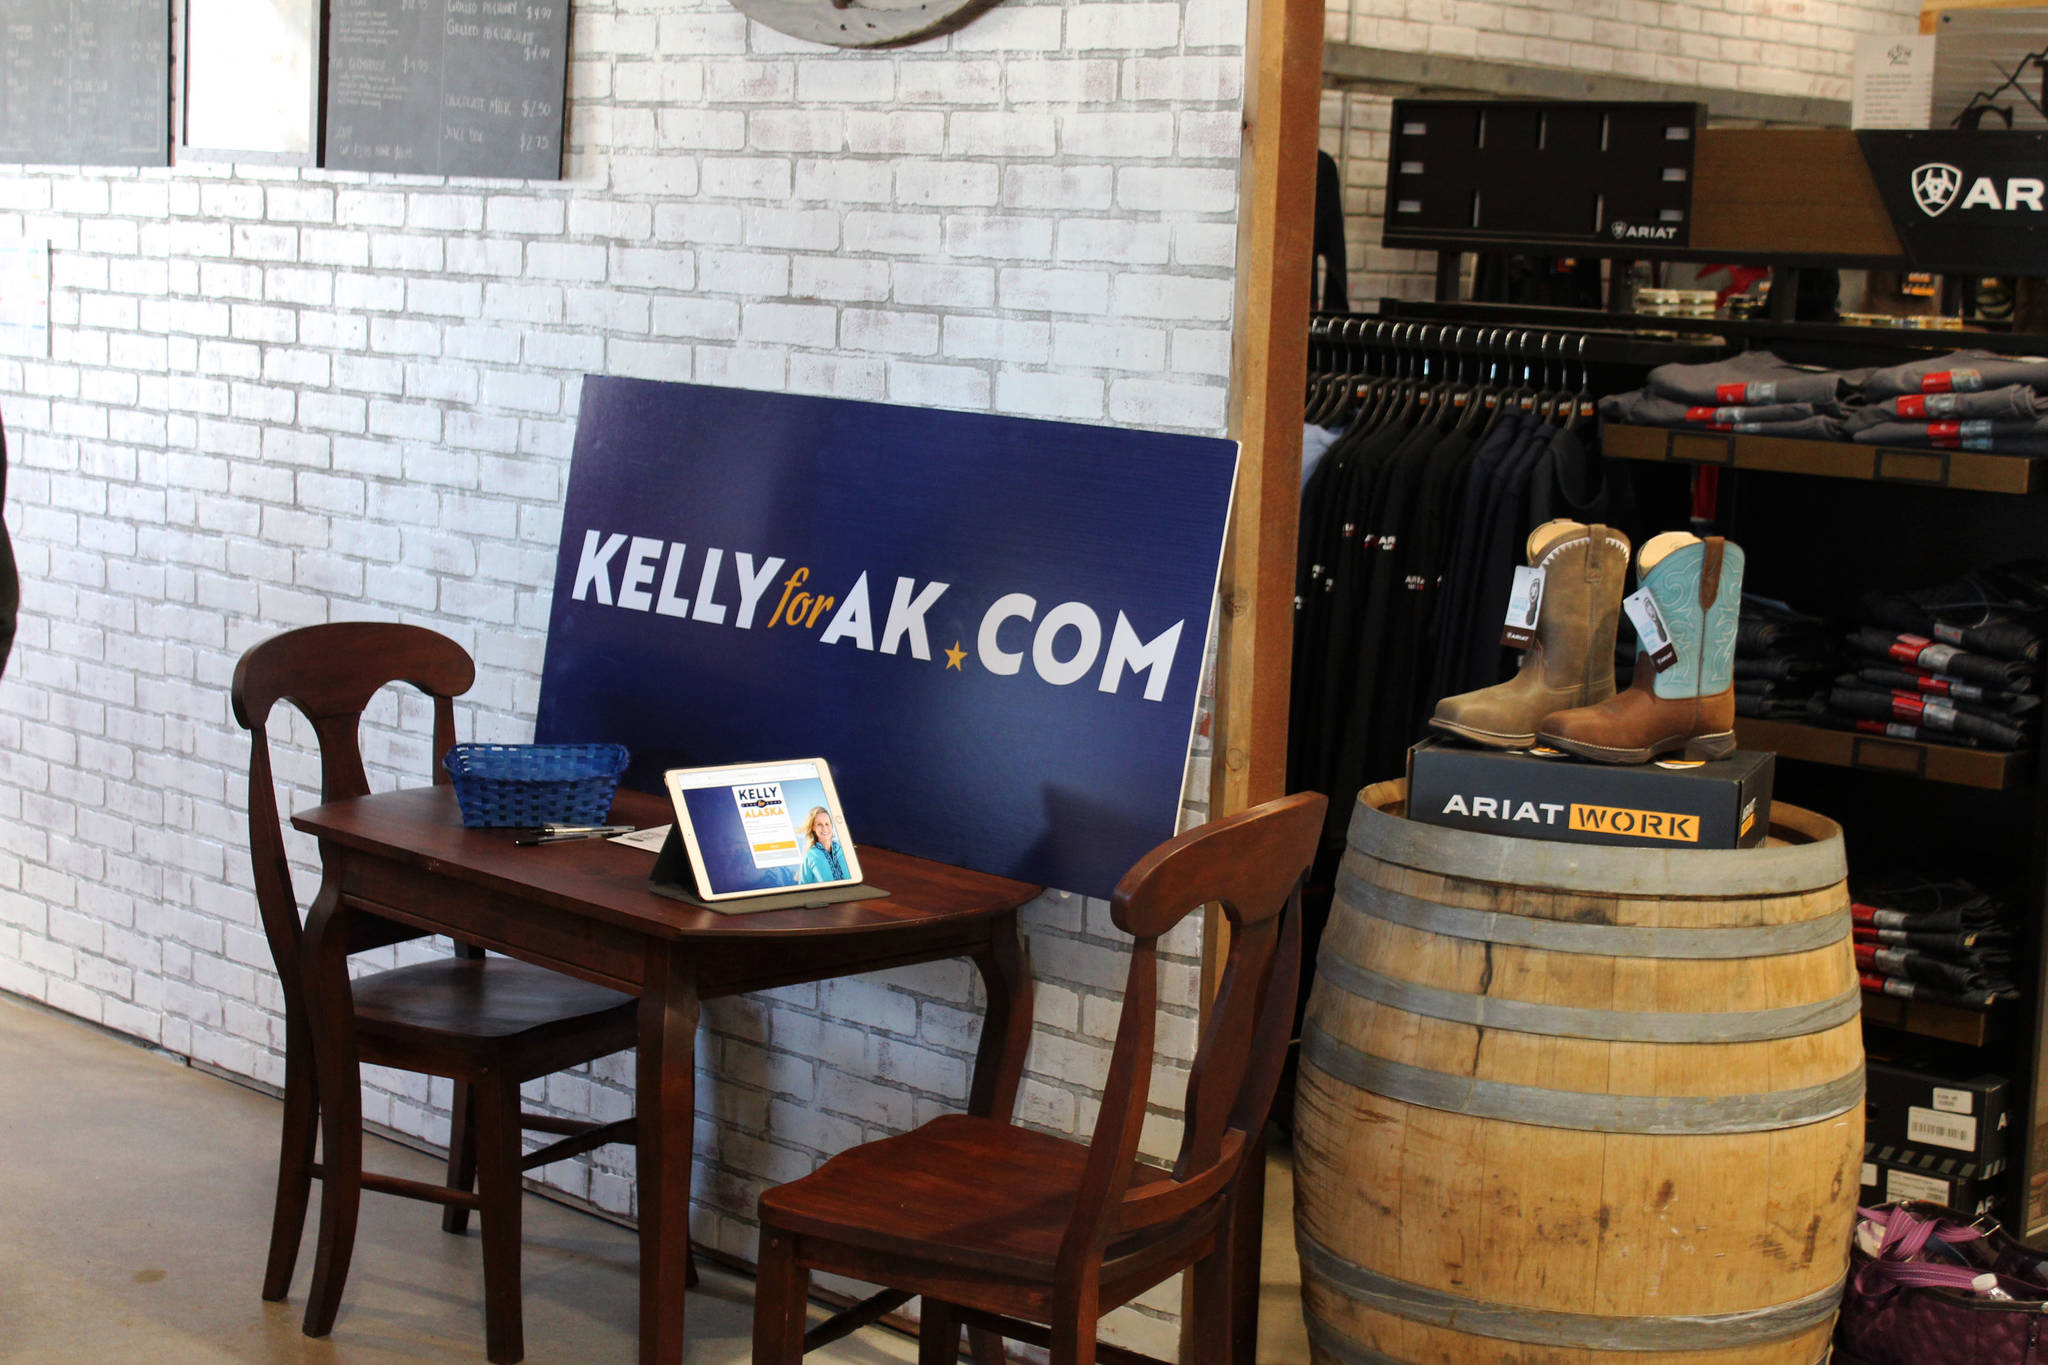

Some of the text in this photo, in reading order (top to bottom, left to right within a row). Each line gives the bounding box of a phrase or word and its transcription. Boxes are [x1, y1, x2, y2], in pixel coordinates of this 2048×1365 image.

[1625, 225, 1678, 239] ARIAT
[571, 528, 786, 629] KELLY
[767, 566, 835, 629] for
[738, 786, 777, 801] KELLY
[744, 806, 785, 819] ALASKA
[1442, 794, 1691, 839] ARIAT WORK
